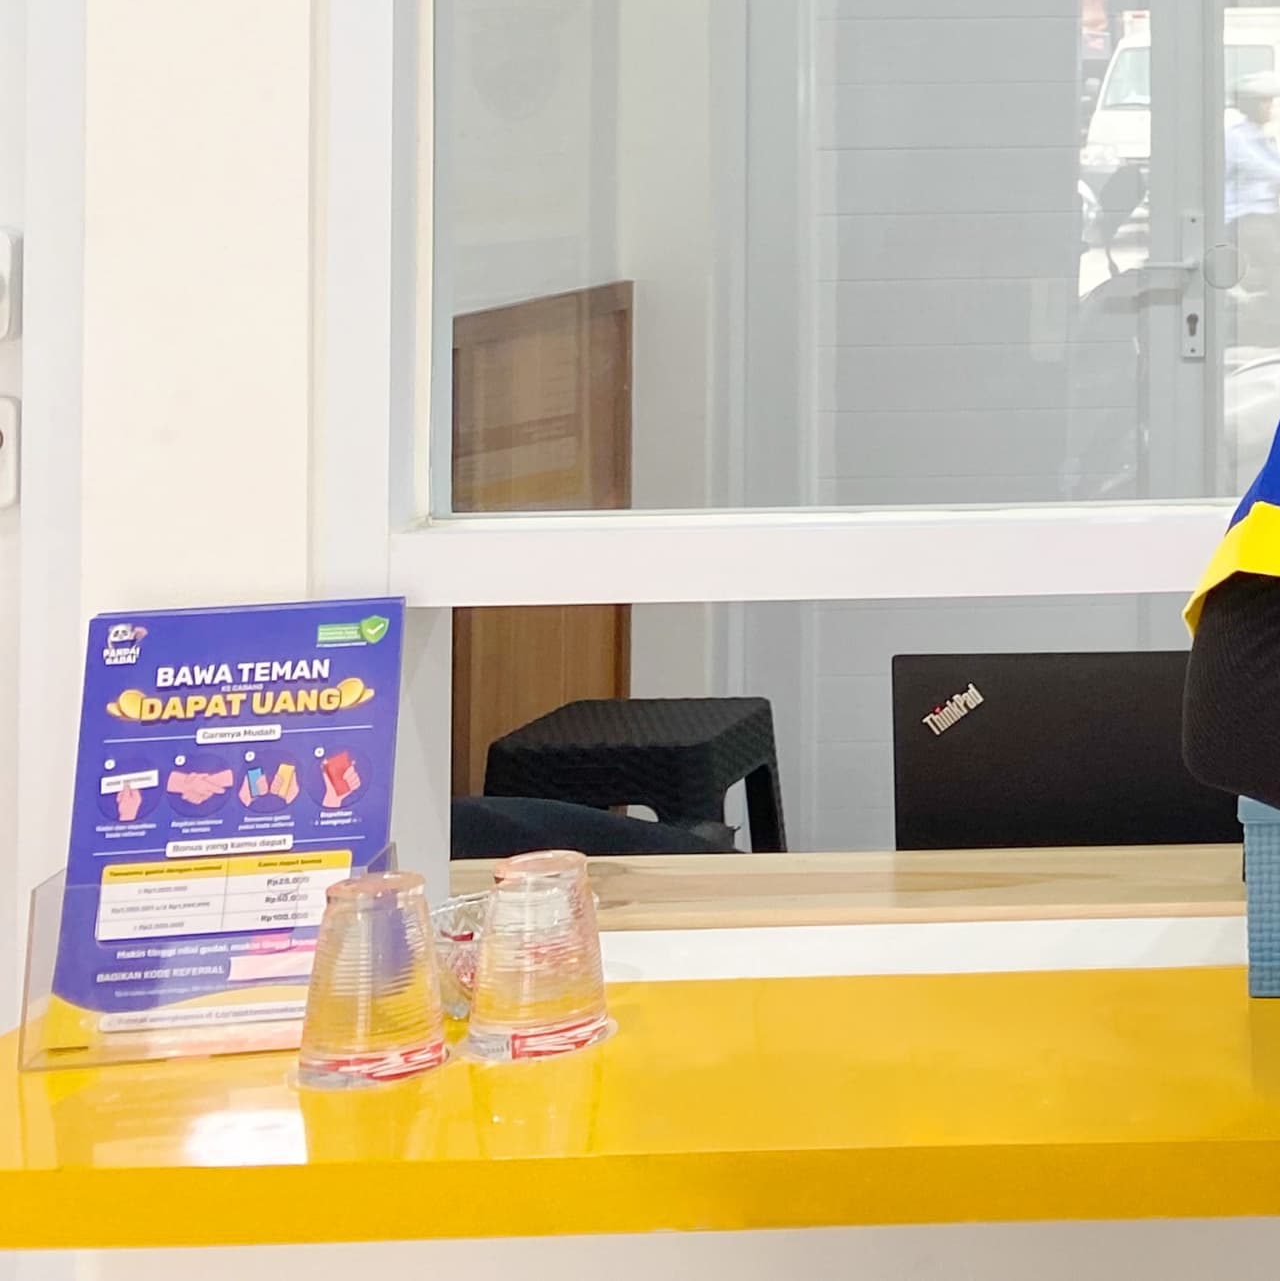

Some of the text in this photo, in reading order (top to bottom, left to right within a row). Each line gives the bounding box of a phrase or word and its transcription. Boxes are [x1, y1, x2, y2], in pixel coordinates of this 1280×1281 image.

[156, 659, 330, 687] BAWA TEMAN
[140, 688, 342, 721] DAPAT UANG
[921, 682, 985, 735] ThinkPad
[243, 727, 276, 738] Mudah
[172, 837, 287, 854] Bonus yang kamu dapat
[172, 965, 225, 978] REFERRAL
